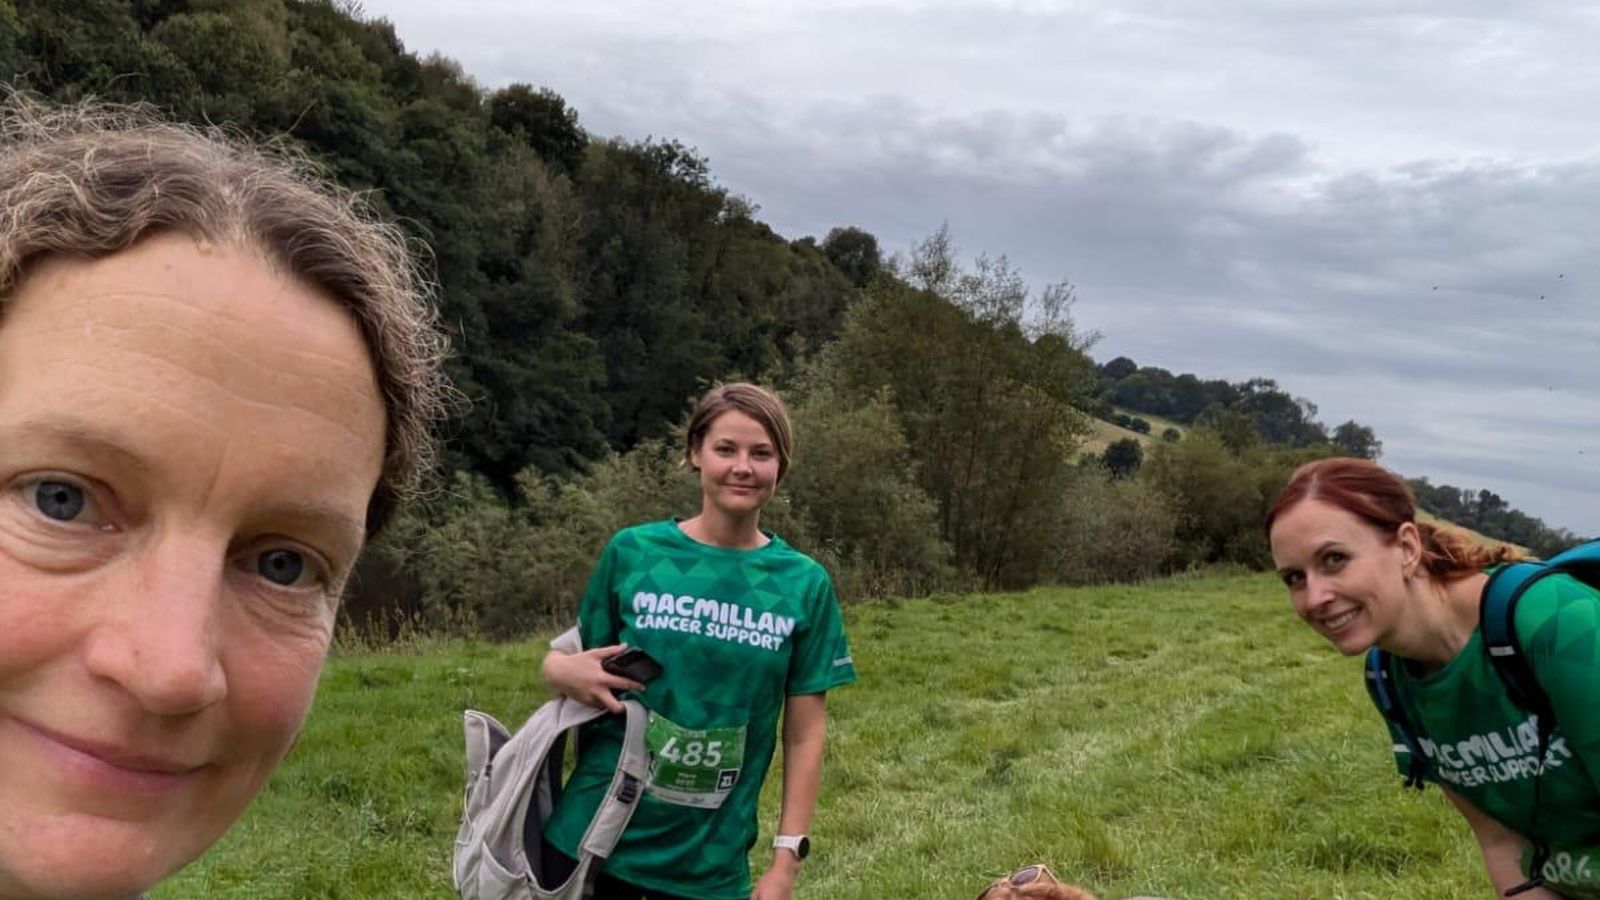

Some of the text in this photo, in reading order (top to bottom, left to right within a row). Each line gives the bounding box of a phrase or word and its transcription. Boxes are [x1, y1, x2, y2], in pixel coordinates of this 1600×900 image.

[632, 591, 795, 637] MACMILLAN
[635, 614, 785, 652] CANCER SUPPORT
[660, 736, 722, 768] 485
